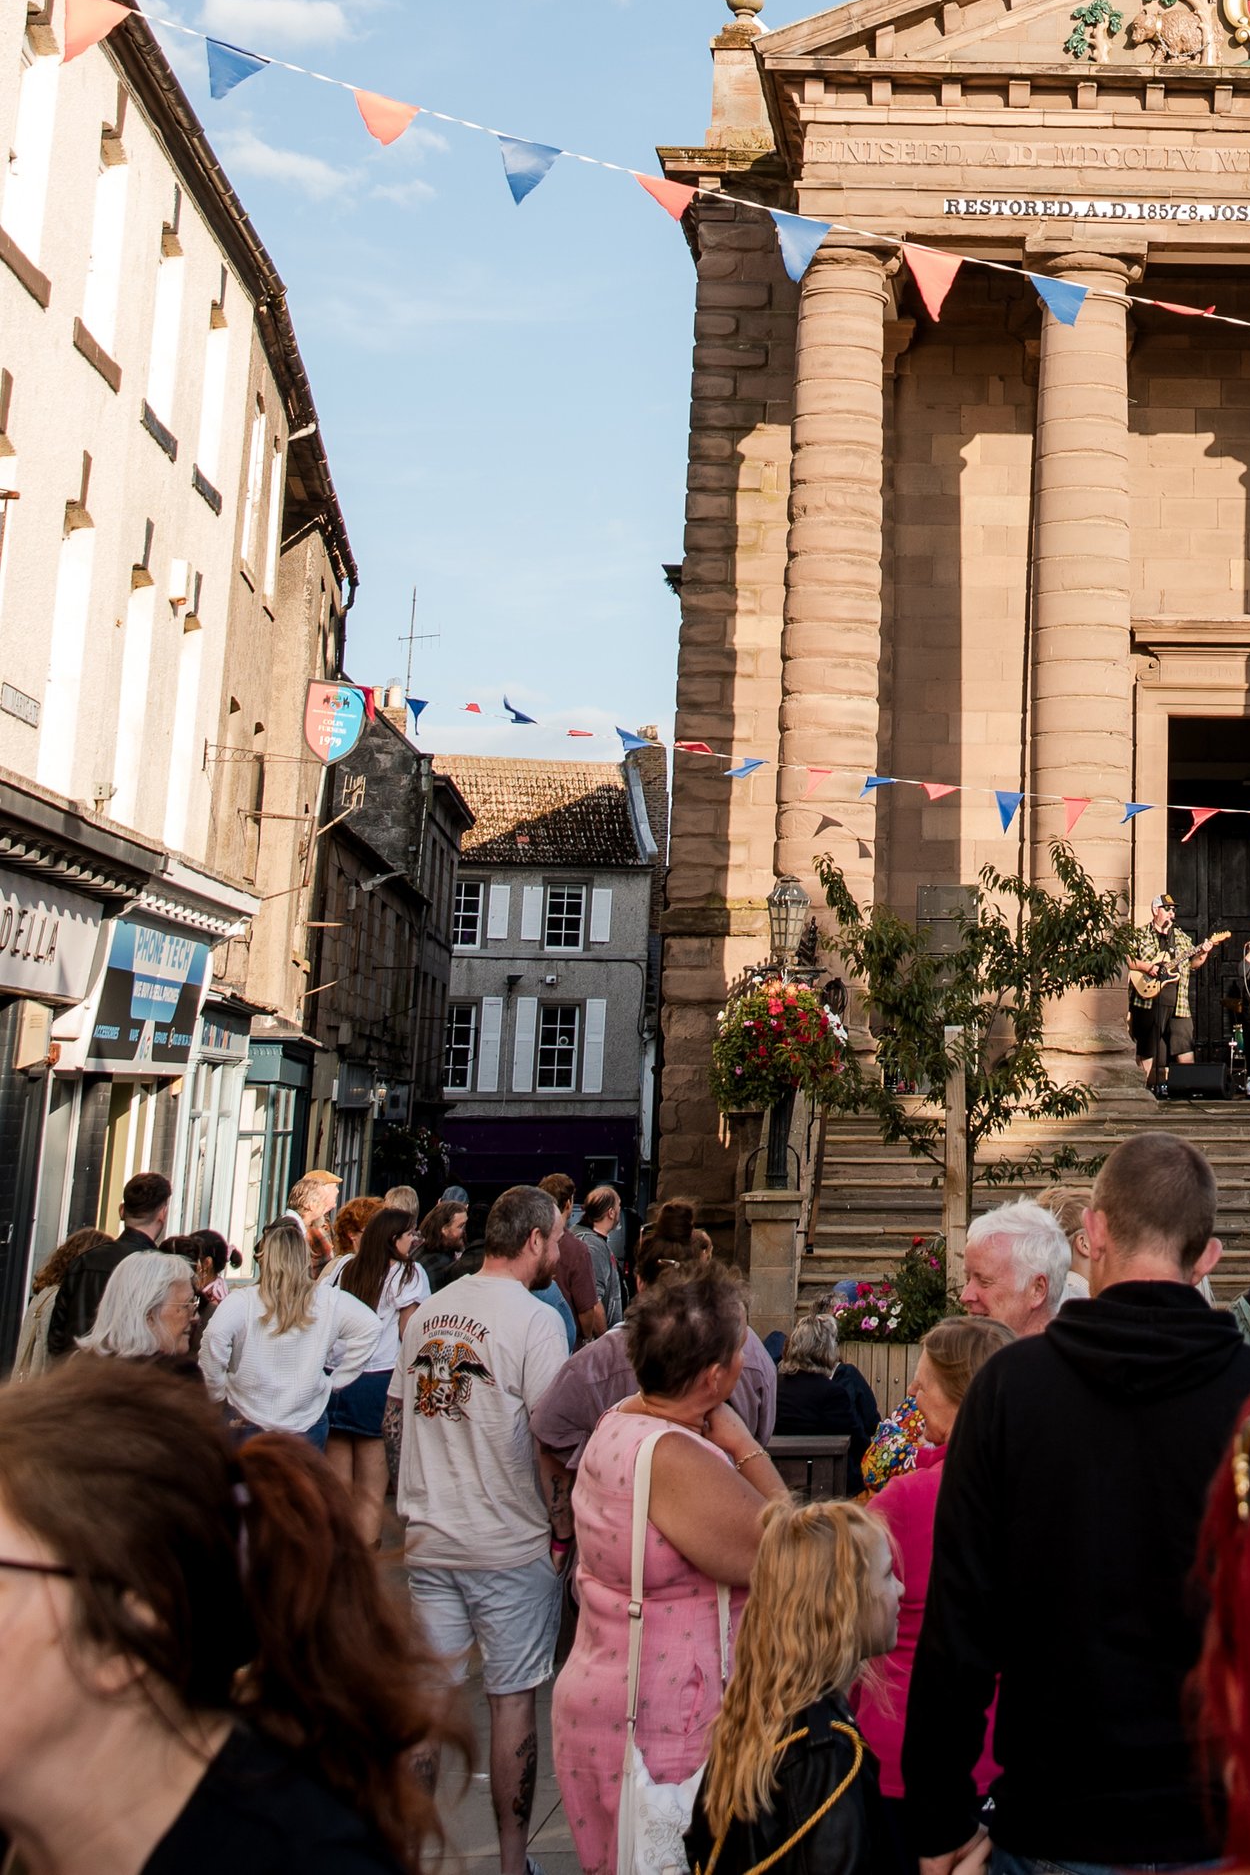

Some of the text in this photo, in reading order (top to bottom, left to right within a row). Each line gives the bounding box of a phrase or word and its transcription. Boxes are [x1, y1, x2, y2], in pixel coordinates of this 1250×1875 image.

[319, 735, 342, 748] 1979
[136, 928, 193, 971] PHONE TECH
[422, 1314, 491, 1344] HOBOJACK
